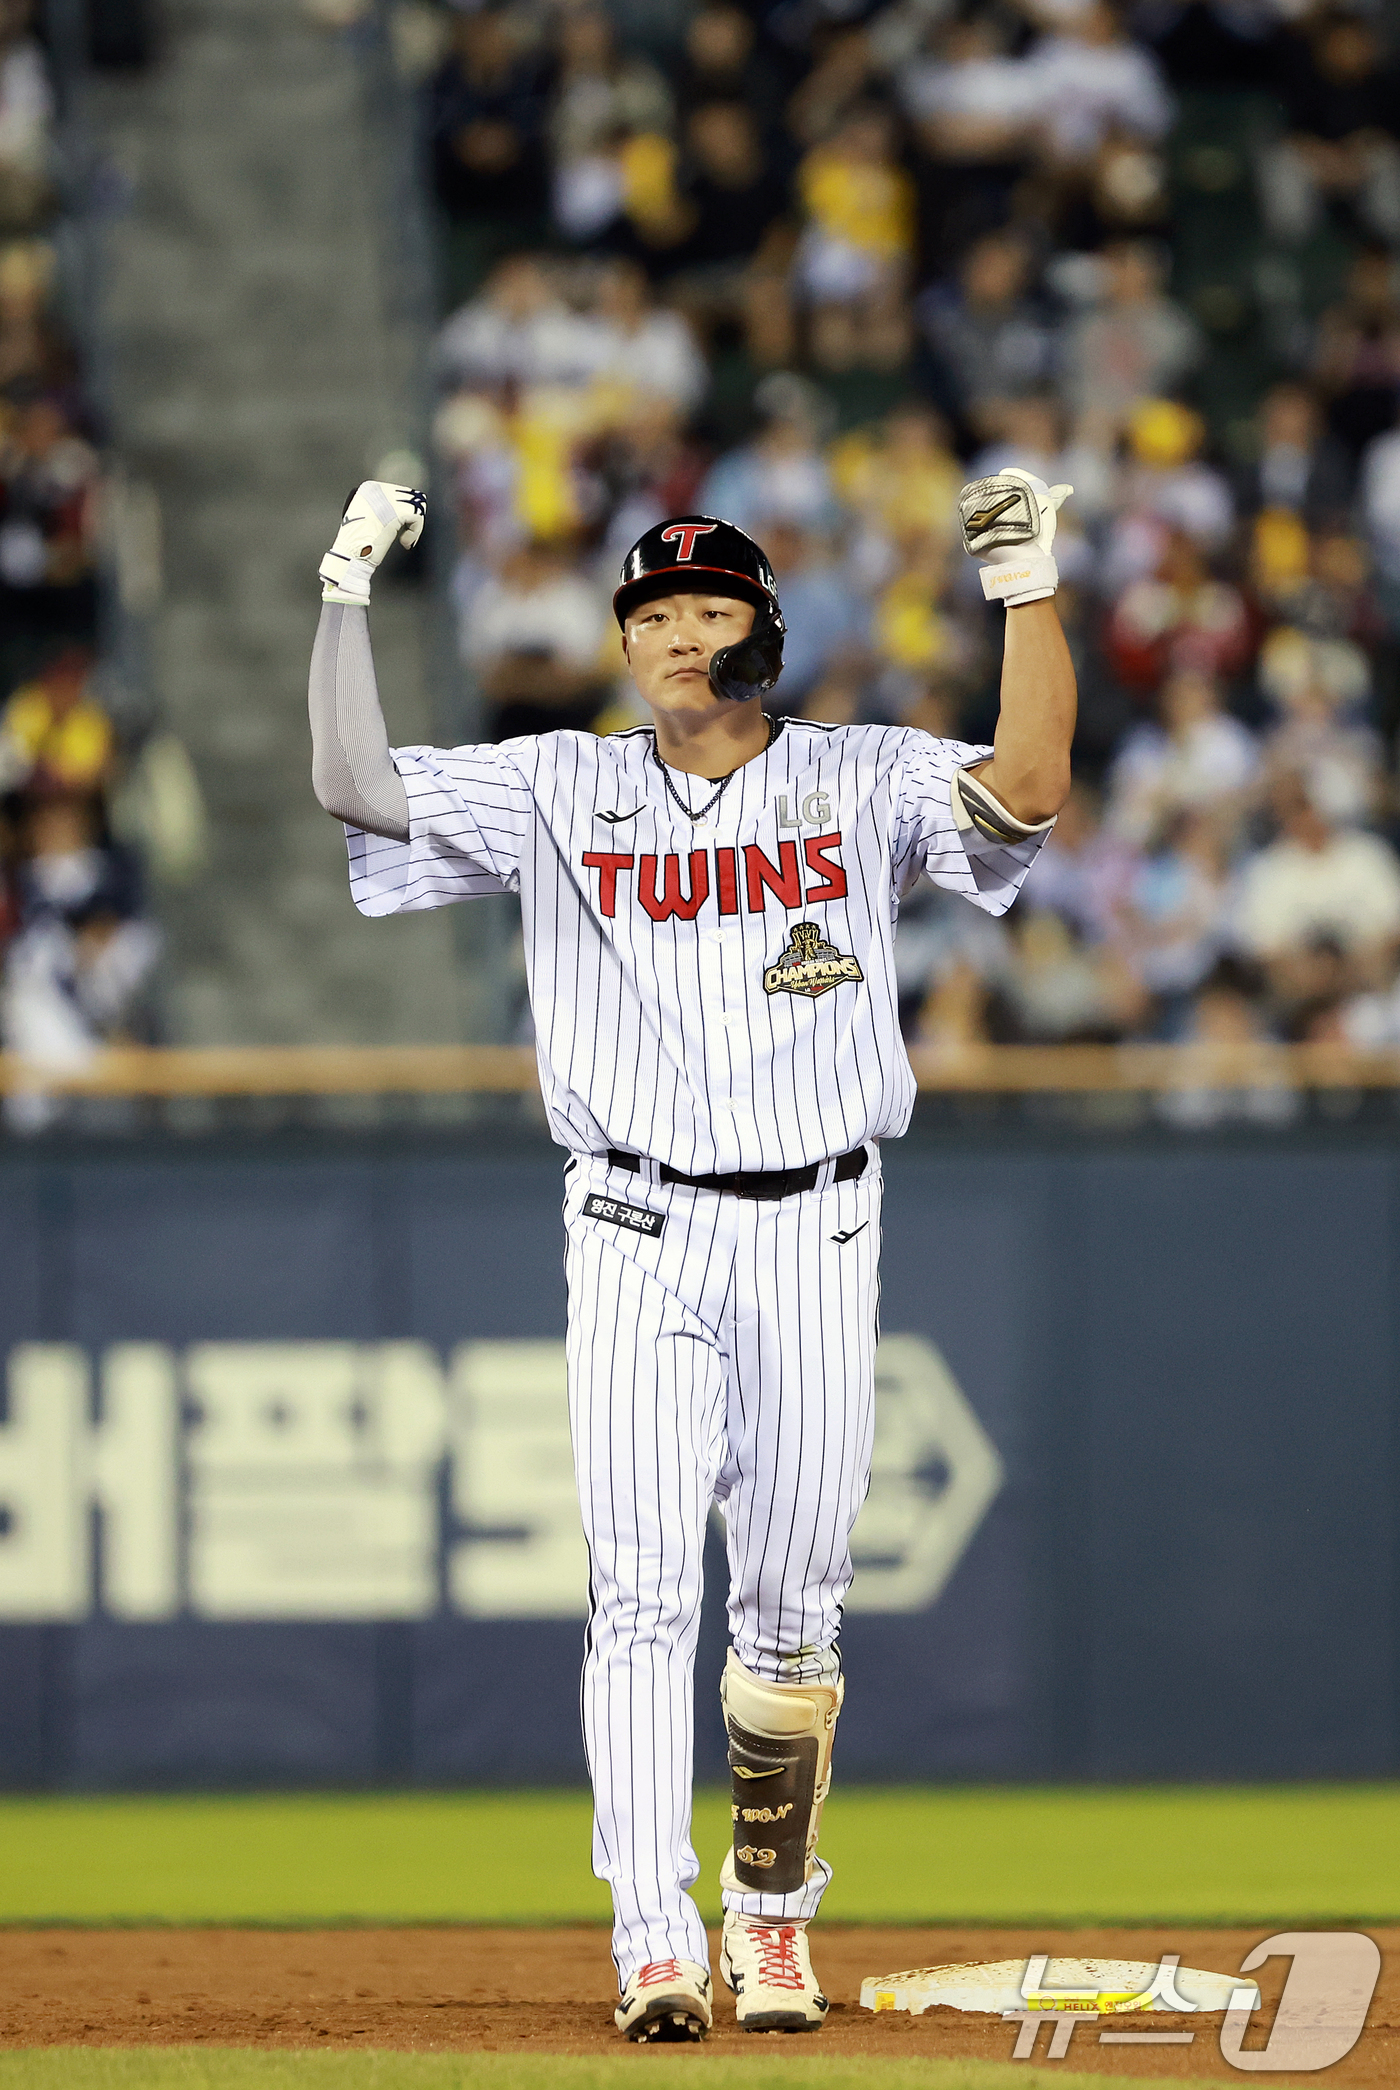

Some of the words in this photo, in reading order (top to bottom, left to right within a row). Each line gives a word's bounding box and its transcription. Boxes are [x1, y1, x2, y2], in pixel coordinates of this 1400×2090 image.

[661, 523, 718, 562] T
[778, 790, 832, 829] LG
[581, 831, 848, 922] TWINS
[766, 958, 859, 989] CHAMPIONS
[590, 1198, 618, 1219] 영진
[617, 1206, 656, 1231] 구론산
[737, 1844, 777, 1869] 52
[1064, 2003, 1100, 2011] HELIX
